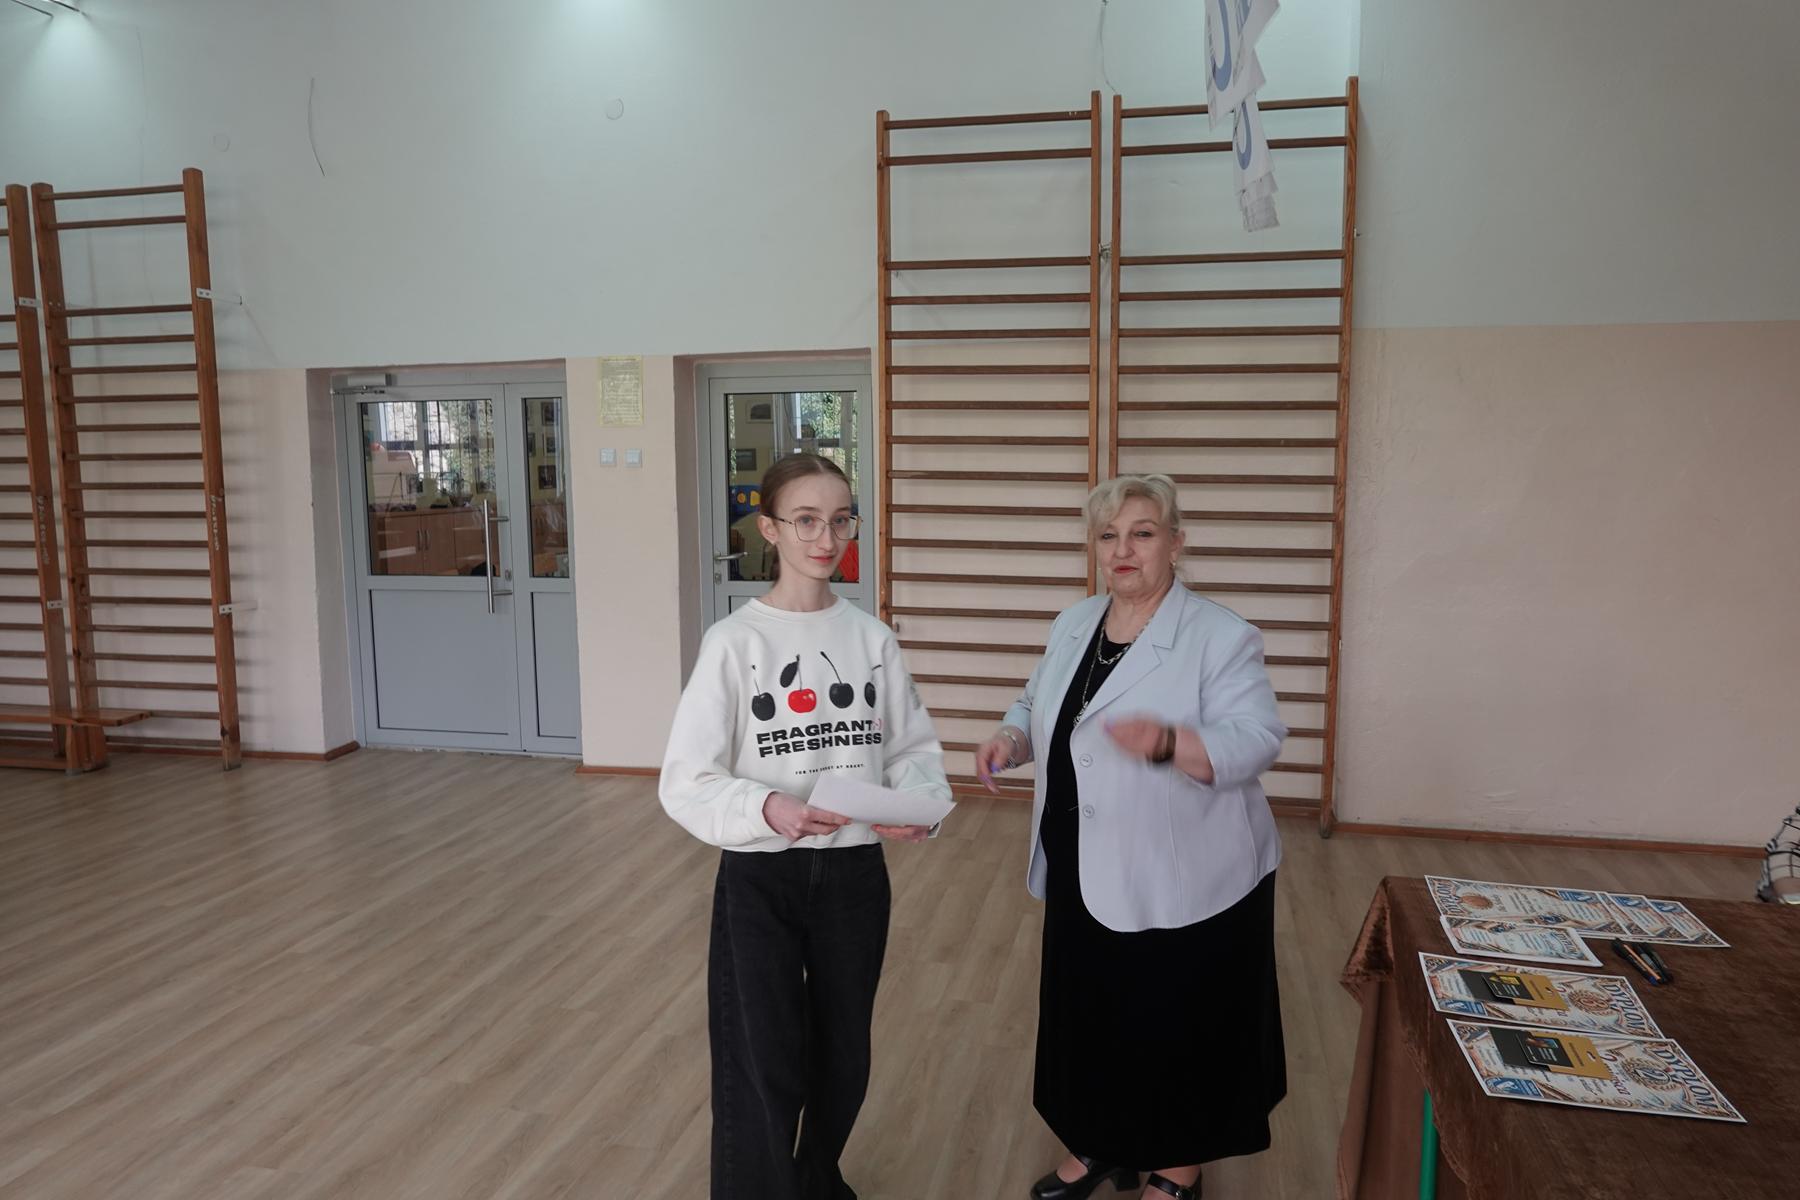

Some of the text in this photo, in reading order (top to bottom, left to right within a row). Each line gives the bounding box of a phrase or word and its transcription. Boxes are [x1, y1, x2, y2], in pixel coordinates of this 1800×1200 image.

[756, 719, 874, 745] FRAGRANT
[758, 732, 883, 758] FRESHNESS
[1602, 984, 1646, 1031] DYPLOM
[1653, 1049, 1719, 1109] DYPLOM
